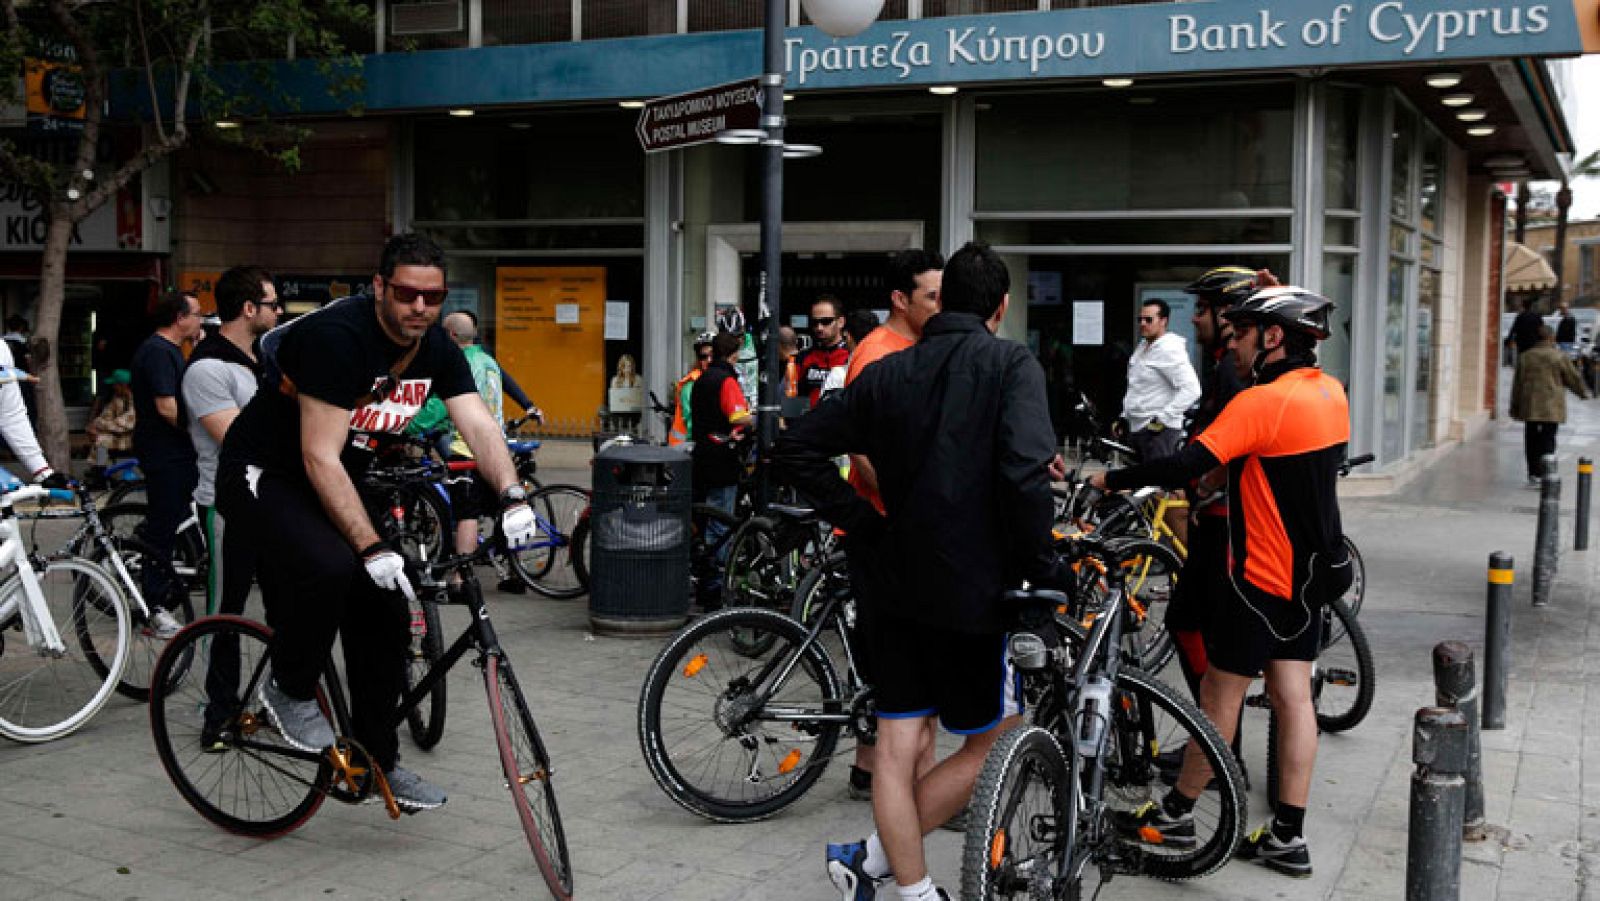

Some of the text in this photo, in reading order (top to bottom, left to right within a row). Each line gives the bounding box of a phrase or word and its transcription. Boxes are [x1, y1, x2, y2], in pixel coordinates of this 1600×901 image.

[947, 26, 1105, 73] Κύπρου
[1169, 2, 1550, 54] Bank of Cyprus
[653, 114, 726, 143] POSTAL MUSEUM
